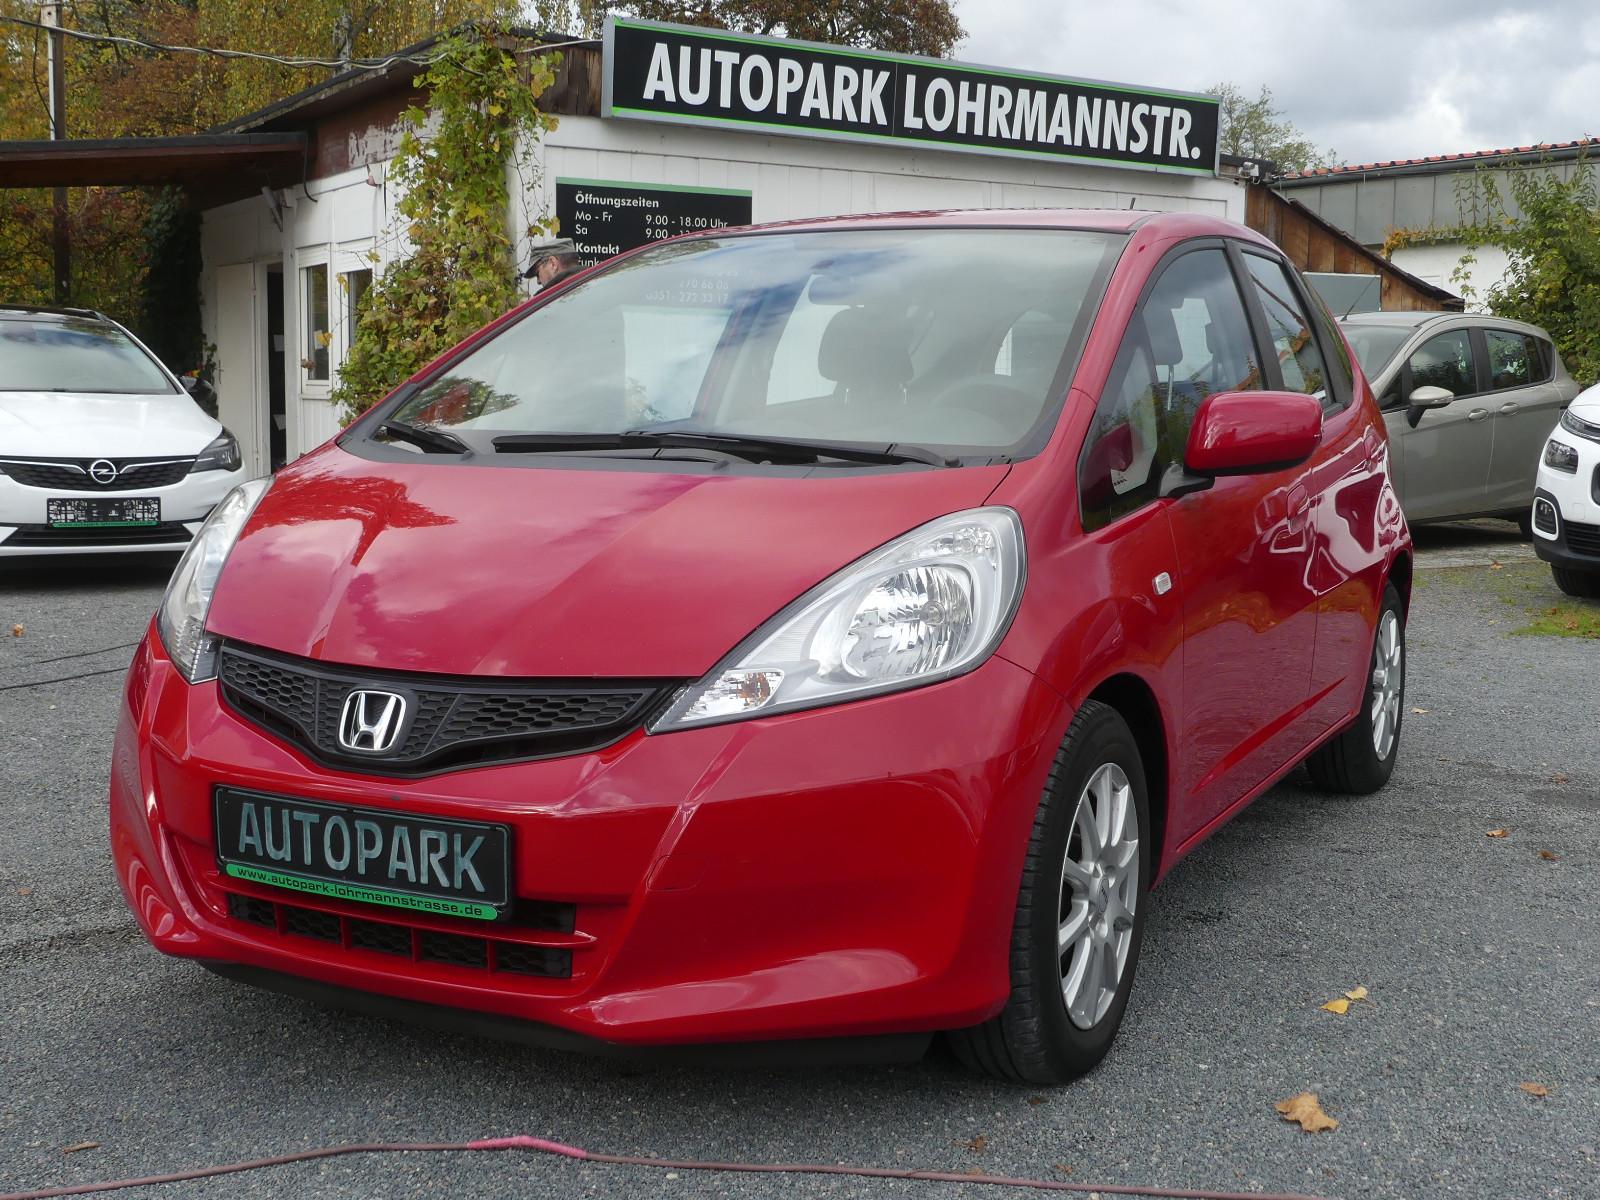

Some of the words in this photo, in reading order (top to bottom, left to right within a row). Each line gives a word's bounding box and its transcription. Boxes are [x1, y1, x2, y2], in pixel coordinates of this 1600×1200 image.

[642, 42, 890, 126] AUTOPARK
[903, 72, 1202, 161] LOHRMANNSTR.
[575, 190, 660, 208] Öffnungszeiten
[575, 211, 592, 221] Mo
[602, 211, 613, 222] Fr
[645, 214, 669, 226] 9.00
[680, 216, 707, 228] 18.00
[710, 218, 728, 229] Uhr
[575, 223, 588, 235] Sa
[645, 228, 669, 239] 9.00
[575, 242, 620, 255] Kontakt
[238, 802, 486, 893] AUTOPARK
[237, 867, 483, 916] www.autopark-lohrmannstrasse.de
